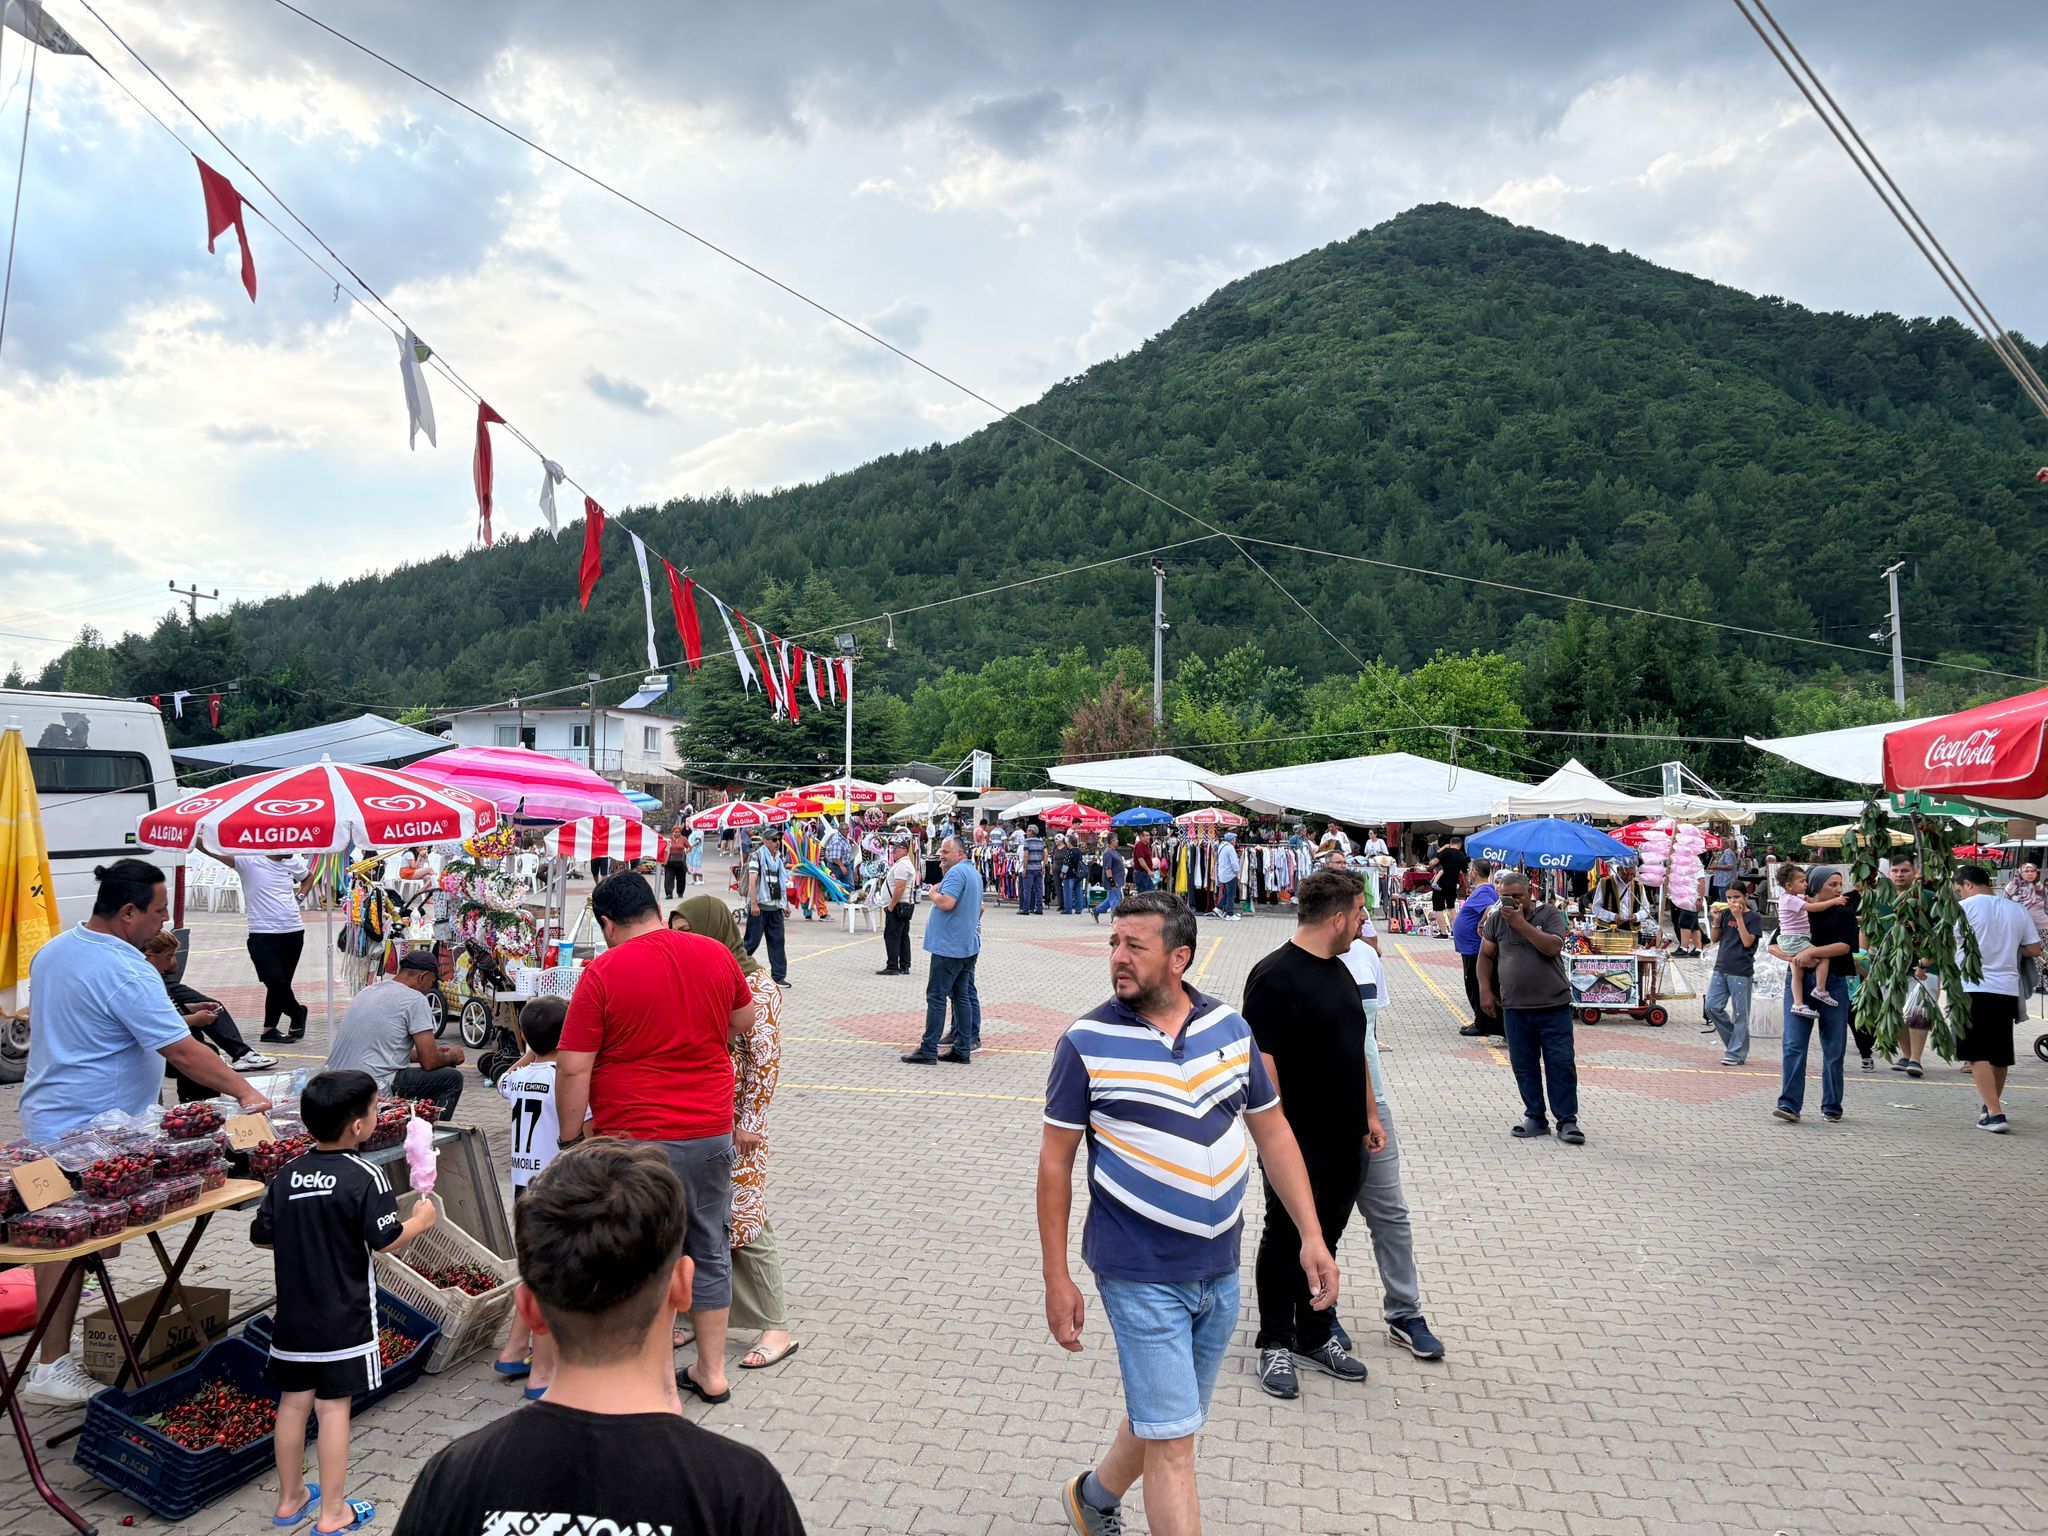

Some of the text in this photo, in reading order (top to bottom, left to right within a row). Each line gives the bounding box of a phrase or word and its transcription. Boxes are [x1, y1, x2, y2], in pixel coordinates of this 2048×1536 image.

[1483, 847, 1507, 862] Golf
[1539, 853, 1572, 867] Golf
[512, 1098, 542, 1153] 17
[32, 1177, 50, 1195] 50
[290, 1170, 337, 1189] beko
[88, 1330, 106, 1340] 200
